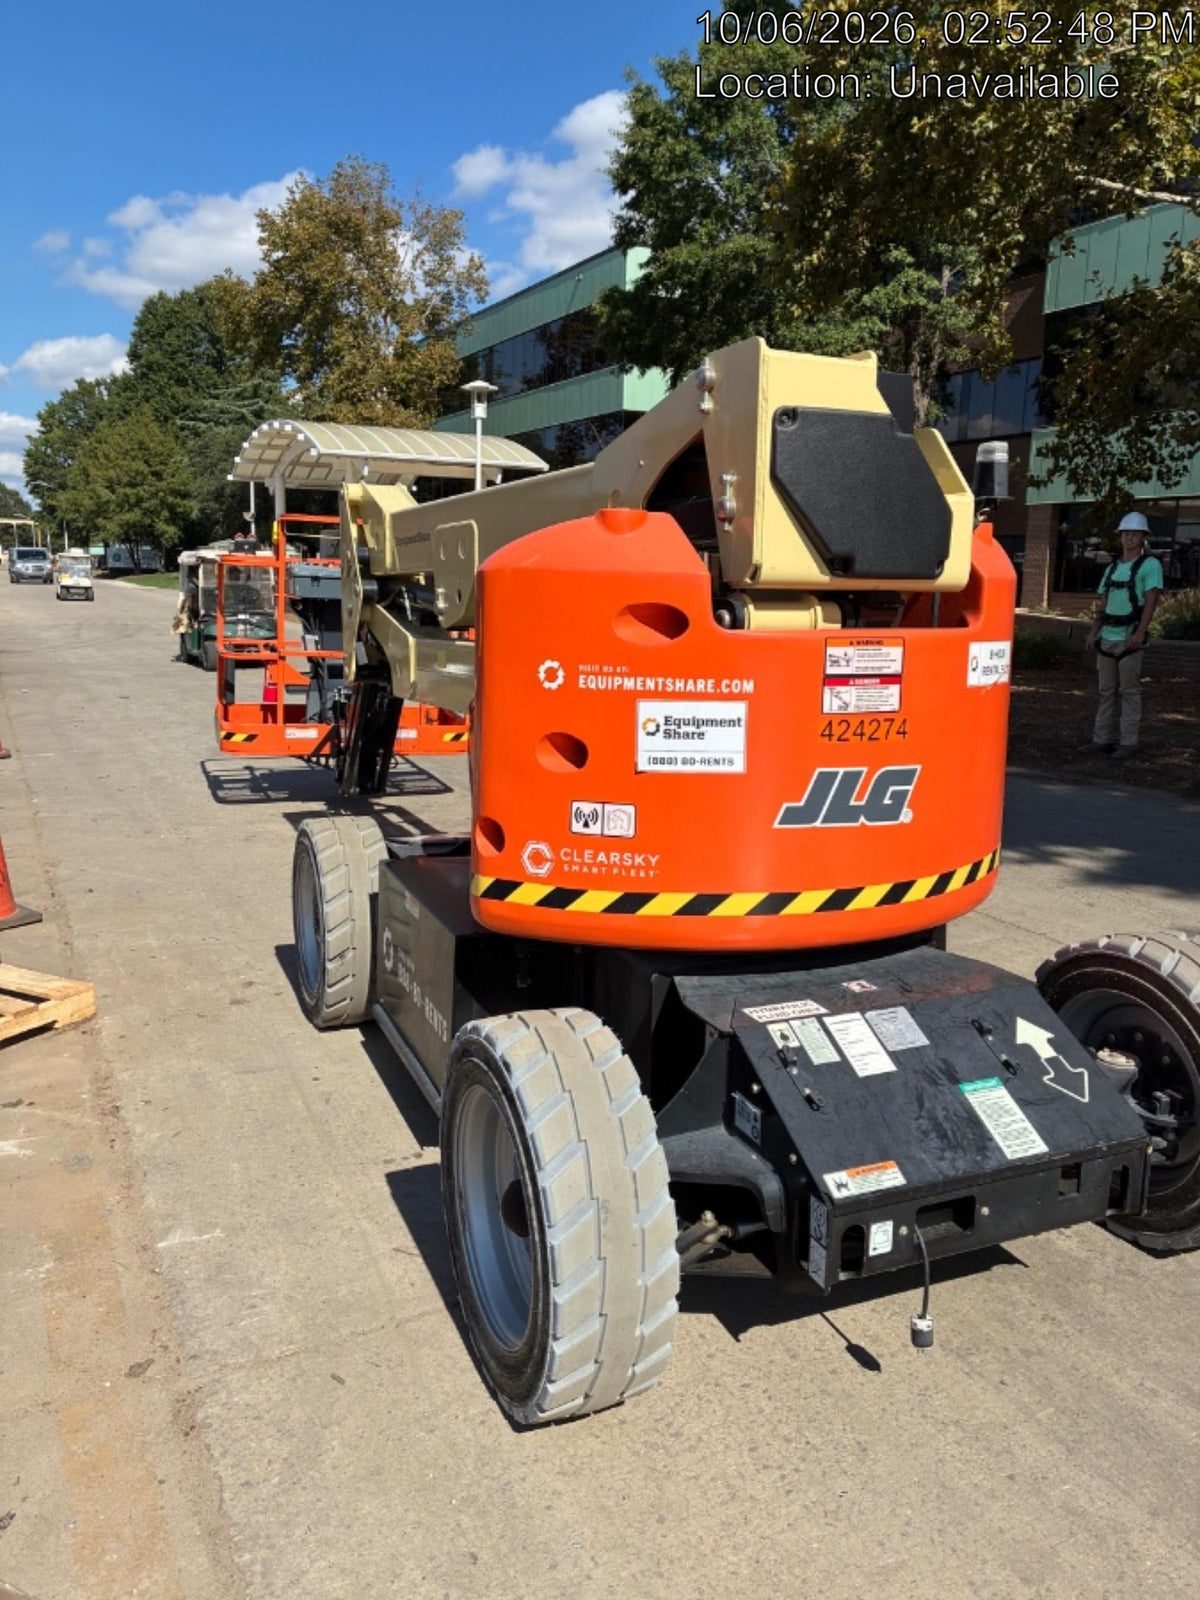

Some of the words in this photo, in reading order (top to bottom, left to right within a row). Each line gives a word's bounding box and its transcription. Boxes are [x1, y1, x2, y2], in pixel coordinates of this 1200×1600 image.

[578, 675, 755, 694] EQUIPMENTSHARE.COM
[663, 715, 743, 730] Equipment
[820, 718, 908, 742] 424274
[663, 728, 706, 741] Share
[772, 764, 922, 829] JLG
[560, 847, 660, 867] CLEARSKY
[563, 863, 607, 875] SMART
